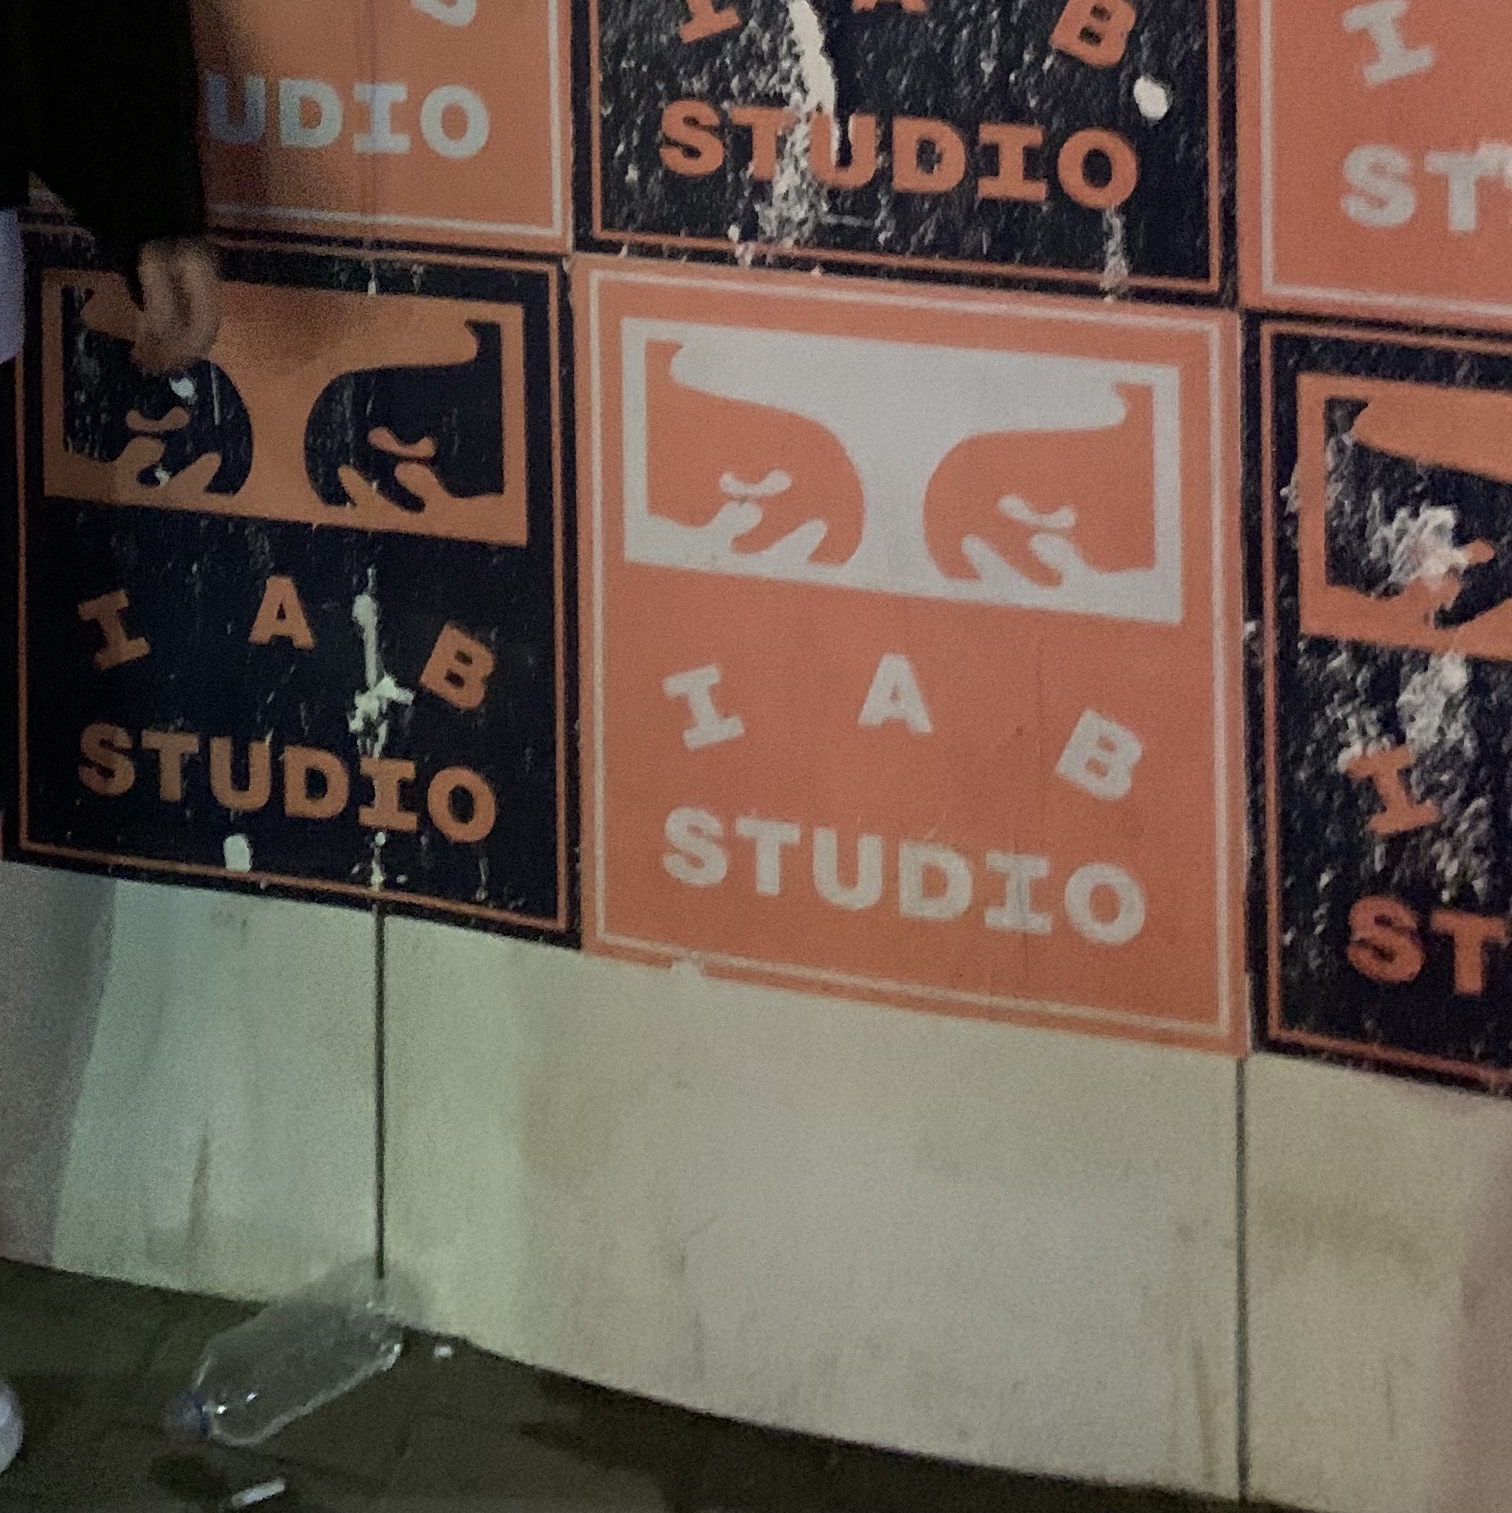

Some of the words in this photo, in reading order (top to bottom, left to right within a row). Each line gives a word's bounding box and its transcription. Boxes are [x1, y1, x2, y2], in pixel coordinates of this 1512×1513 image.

[659, 99, 1138, 210] STUDIO
[78, 721, 497, 844] STUDIO
[662, 805, 1147, 946] STUDIO
